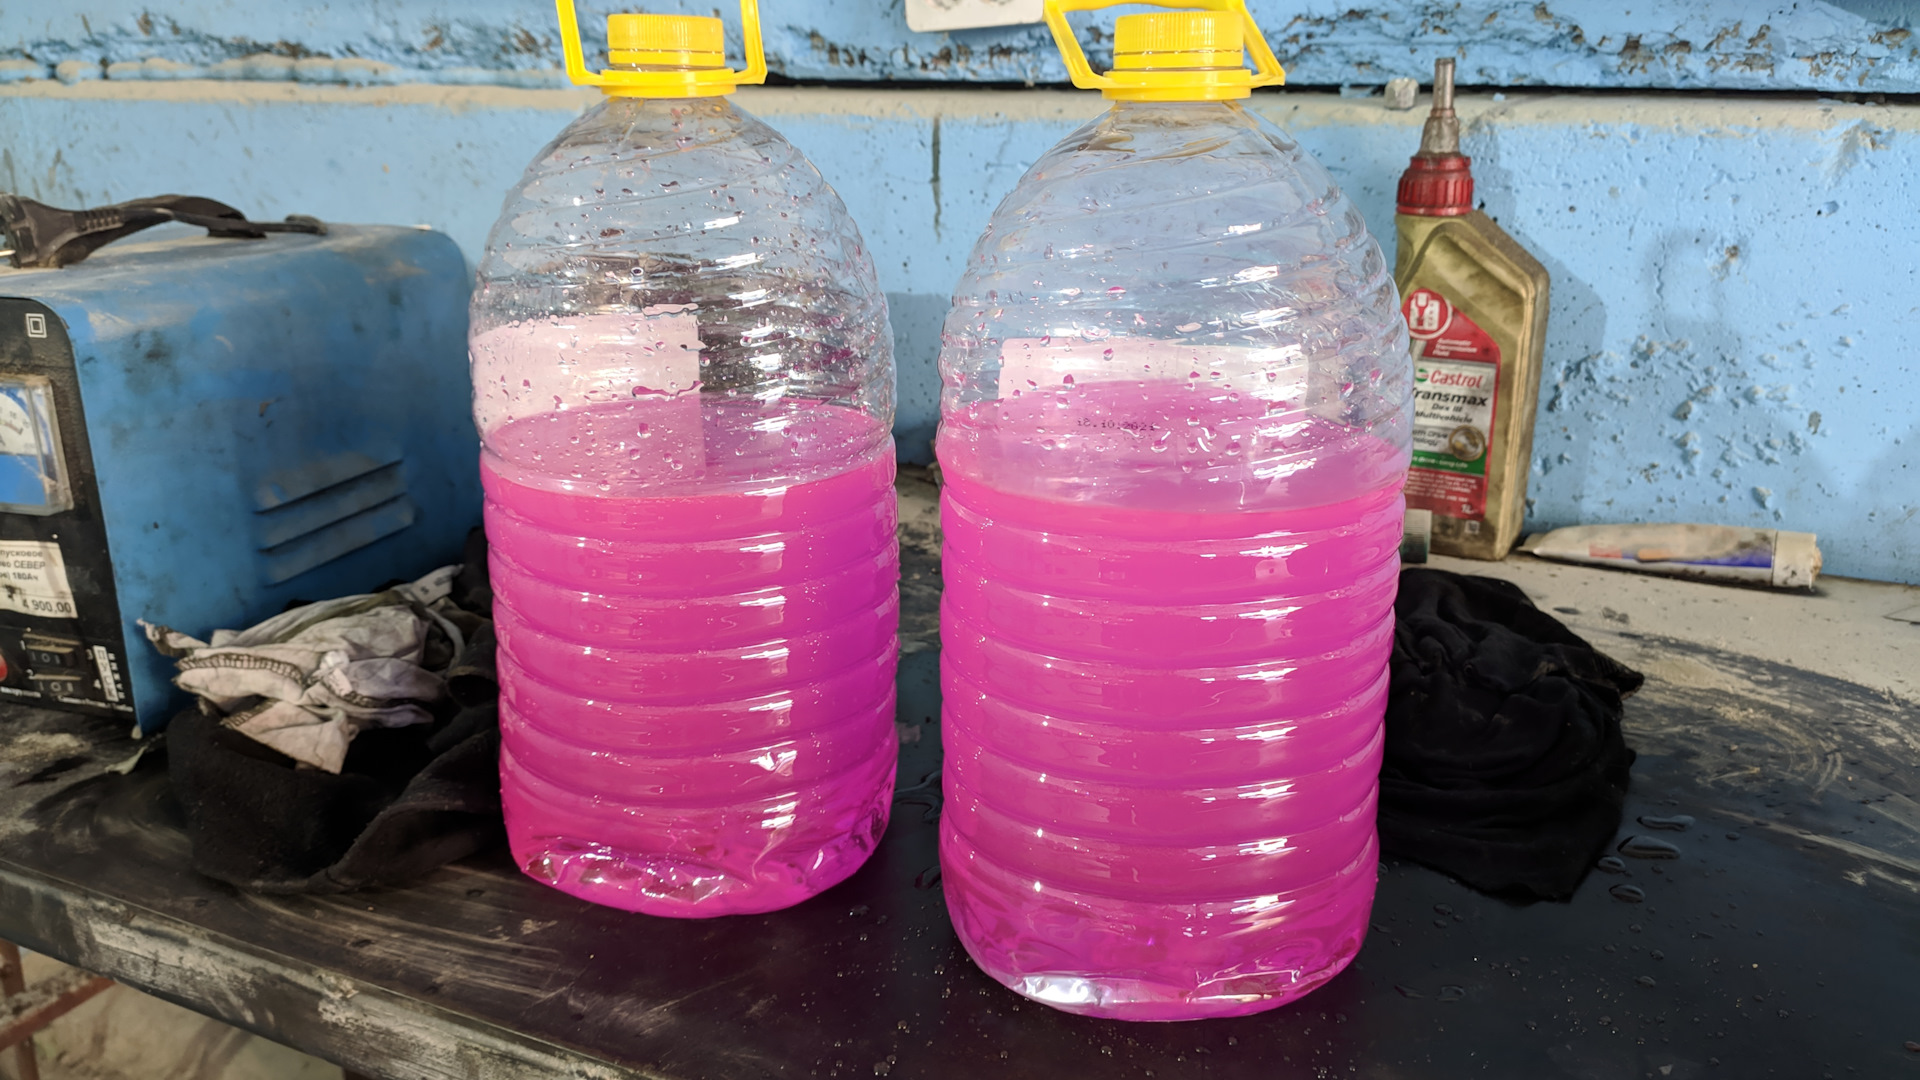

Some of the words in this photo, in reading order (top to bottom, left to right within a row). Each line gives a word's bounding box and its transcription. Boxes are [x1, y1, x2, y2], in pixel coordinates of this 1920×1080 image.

[1430, 370, 1484, 388] Castrol
[1432, 403, 1450, 411] Dex
[1415, 411, 1473, 424] Multivehicle
[13, 560, 46, 570] СЕВЕР
[31, 599, 72, 614] 900,00
